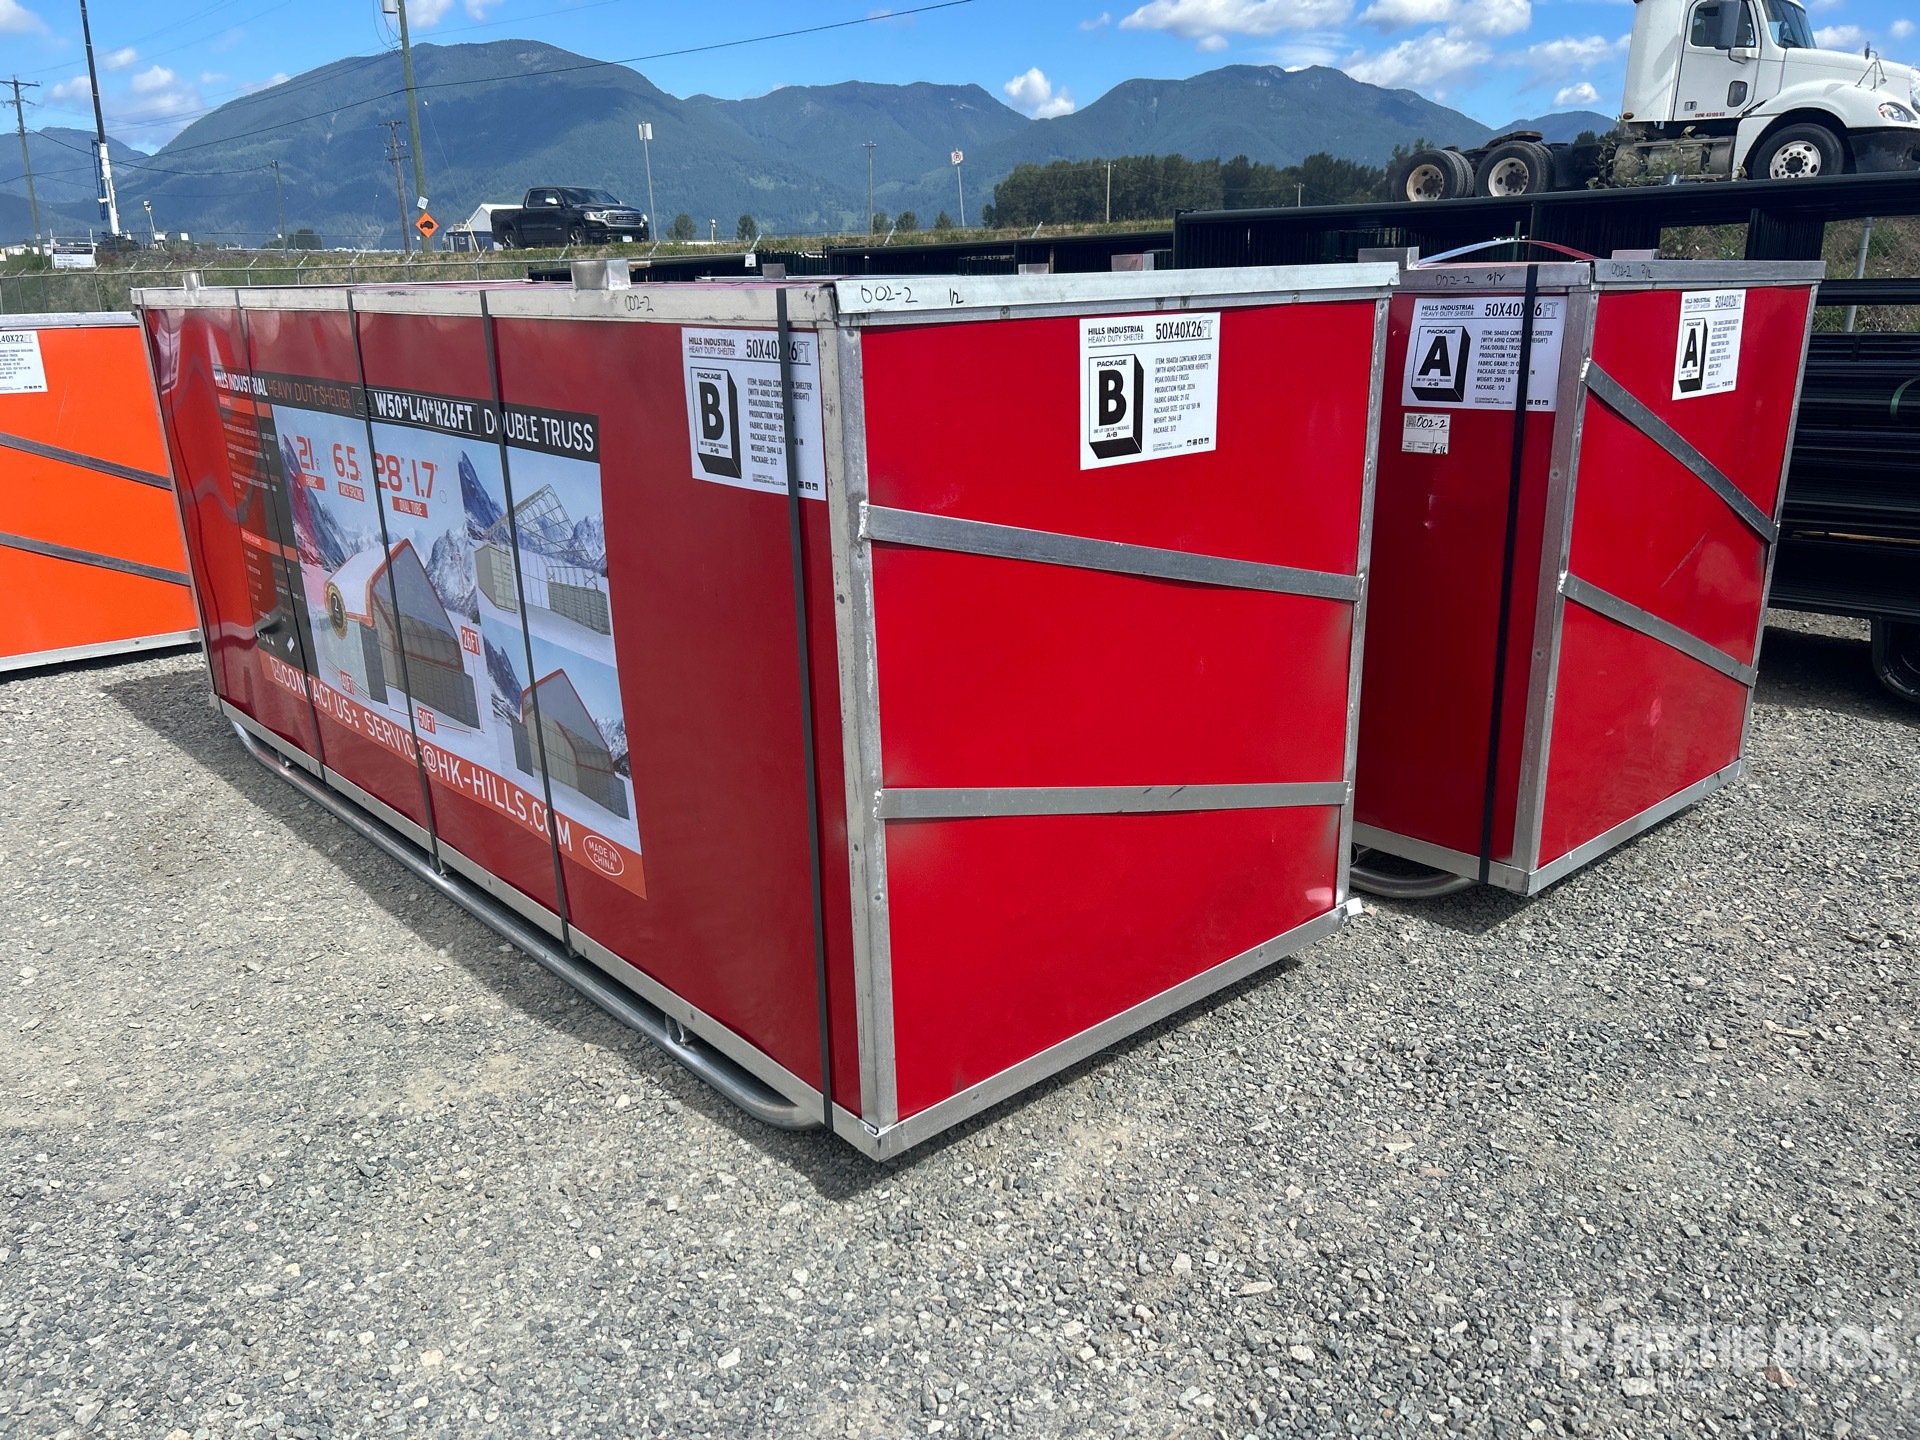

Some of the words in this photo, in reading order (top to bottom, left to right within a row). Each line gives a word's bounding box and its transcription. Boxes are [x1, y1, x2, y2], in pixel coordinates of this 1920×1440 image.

[1088, 327, 1105, 336] HILLS
[1107, 325, 1144, 335] INDUSTRIAL
[1088, 335, 1106, 344] HEAVY
[1107, 334, 1122, 343] DUTY
[1123, 333, 1143, 342] SHELTER
[688, 337, 703, 345] HILLS
[703, 337, 736, 347] INDUSTRIAL
[688, 346, 704, 354] HEAVY
[704, 346, 717, 354] DUTY
[717, 347, 736, 356] SHELTER
[1682, 328, 1698, 368] A
[1096, 359, 1127, 368] PACKAGE
[1417, 336, 1451, 376] A
[696, 372, 722, 380] PACKAGE
[1098, 369, 1127, 426] B
[267, 379, 293, 400] HEAVY
[319, 385, 352, 410] SHELTER
[541, 417, 594, 453] TRUSS
[698, 382, 725, 440] B
[748, 410, 773, 420] PRODUCTION
[749, 421, 763, 430] FABRIC
[1416, 416, 1448, 429] 002-2
[750, 432, 767, 442] PACKAGE
[296, 435, 315, 471] 21
[333, 443, 359, 482] 6.5
[461, 628, 480, 653] 26FT
[333, 692, 360, 729] US:
[418, 709, 435, 733] 50FT
[588, 840, 608, 859] MADE
[609, 850, 618, 863] IN
[593, 853, 616, 873] CHINA
